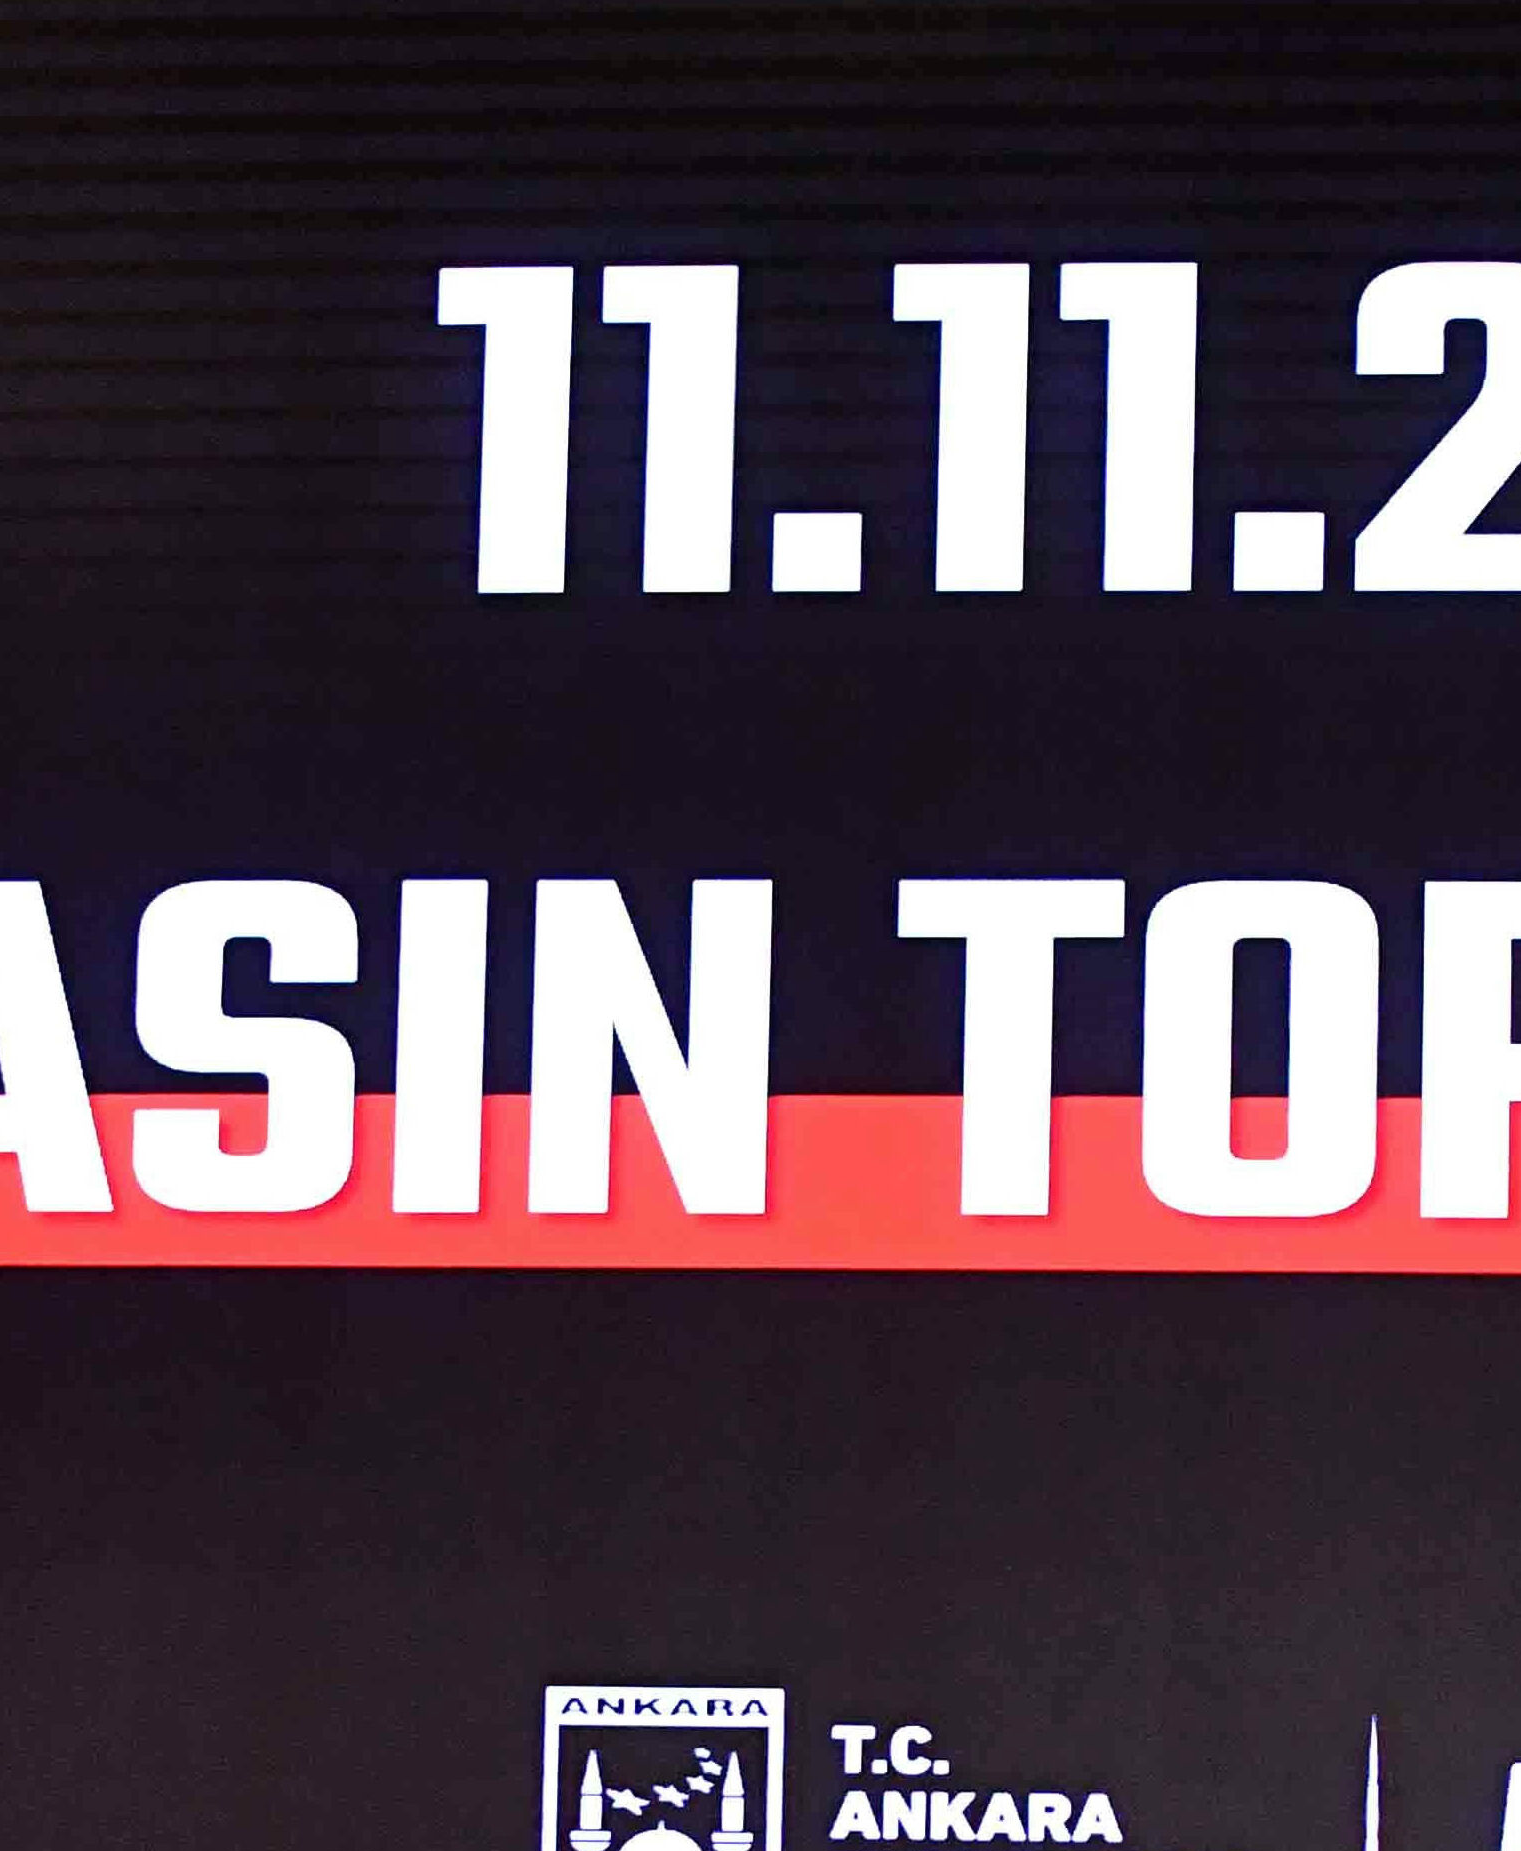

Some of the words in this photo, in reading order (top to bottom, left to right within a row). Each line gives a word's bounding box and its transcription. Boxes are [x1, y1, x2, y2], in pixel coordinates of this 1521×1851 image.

[562, 1698, 768, 1716] ANKARA
[831, 1724, 950, 1775] T.C.
[829, 1790, 1123, 1843] ANKARA
